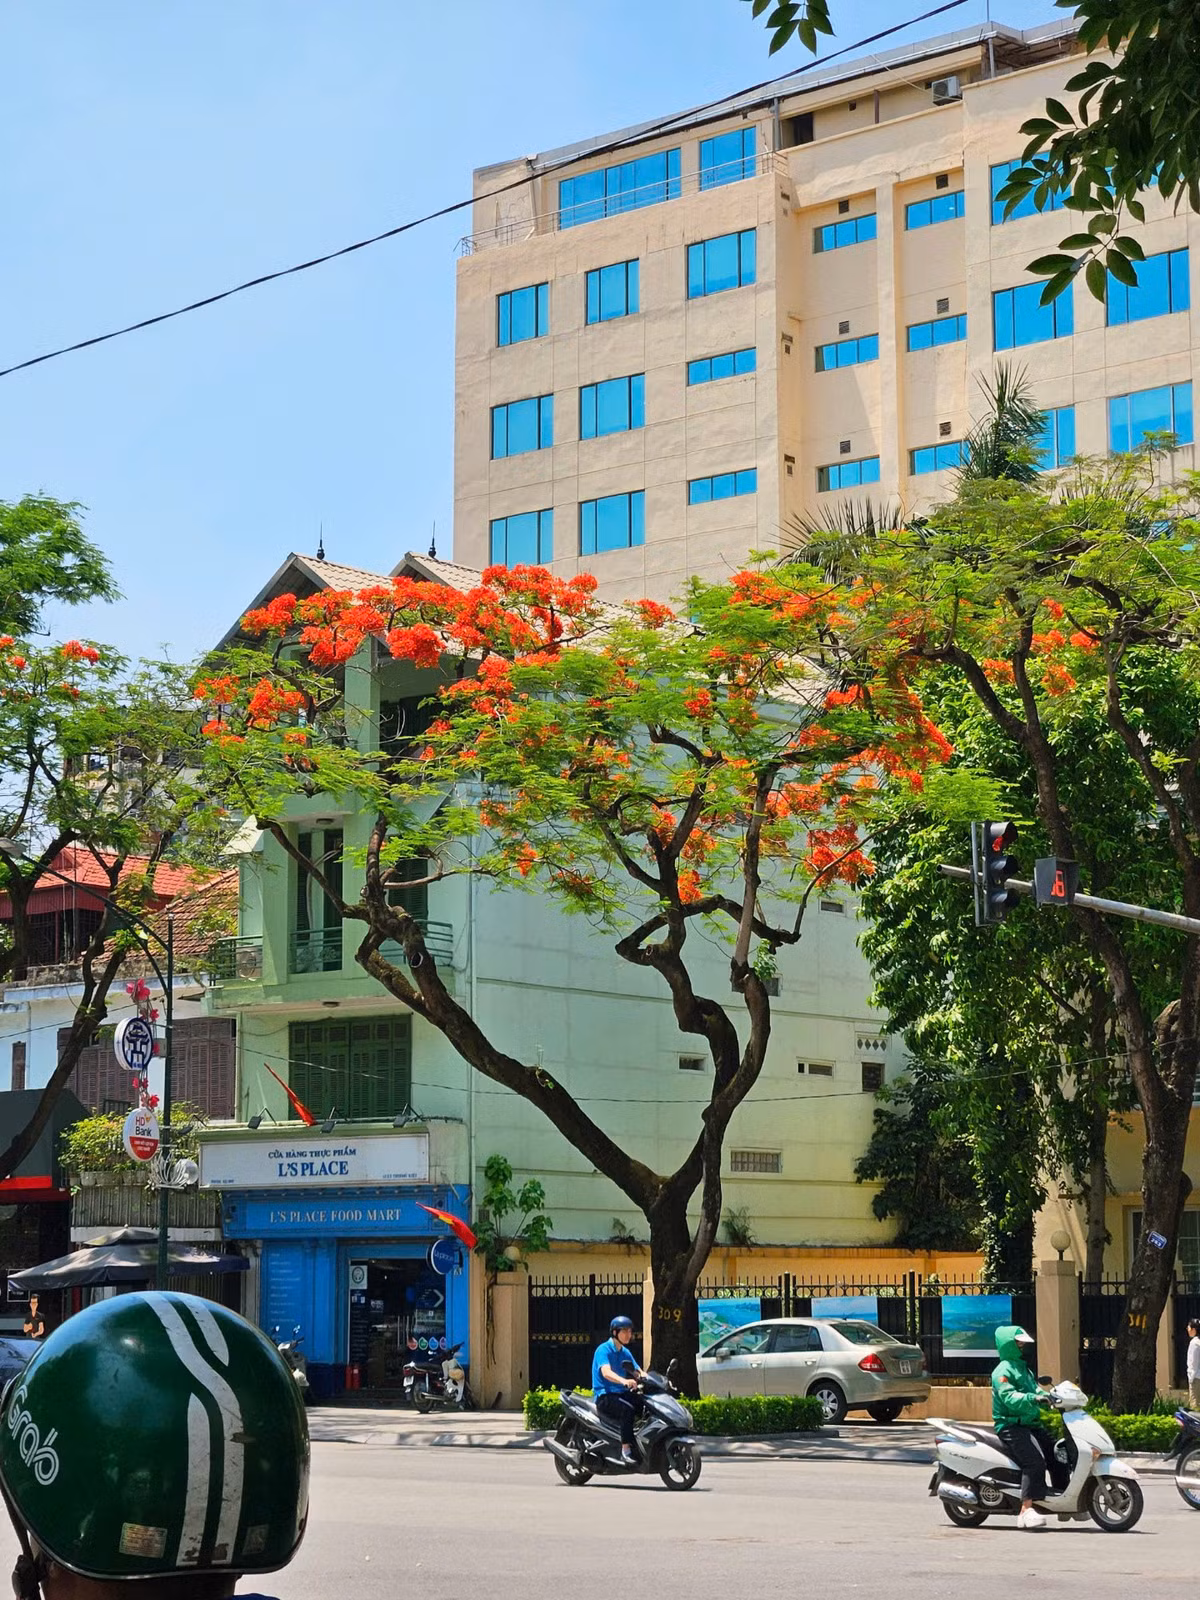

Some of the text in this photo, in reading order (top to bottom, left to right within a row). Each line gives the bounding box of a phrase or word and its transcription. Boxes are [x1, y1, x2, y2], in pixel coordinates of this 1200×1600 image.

[135, 1116, 146, 1126] HD
[135, 1126, 152, 1136] Bank
[268, 1145, 356, 1159] CỬA HÀNG THỰC PHẨM
[301, 1160, 349, 1176] PLACE
[270, 1208, 401, 1223] L'S PLACE FOOD MART
[657, 1305, 682, 1322] 309
[8, 1384, 58, 1486] Grab
